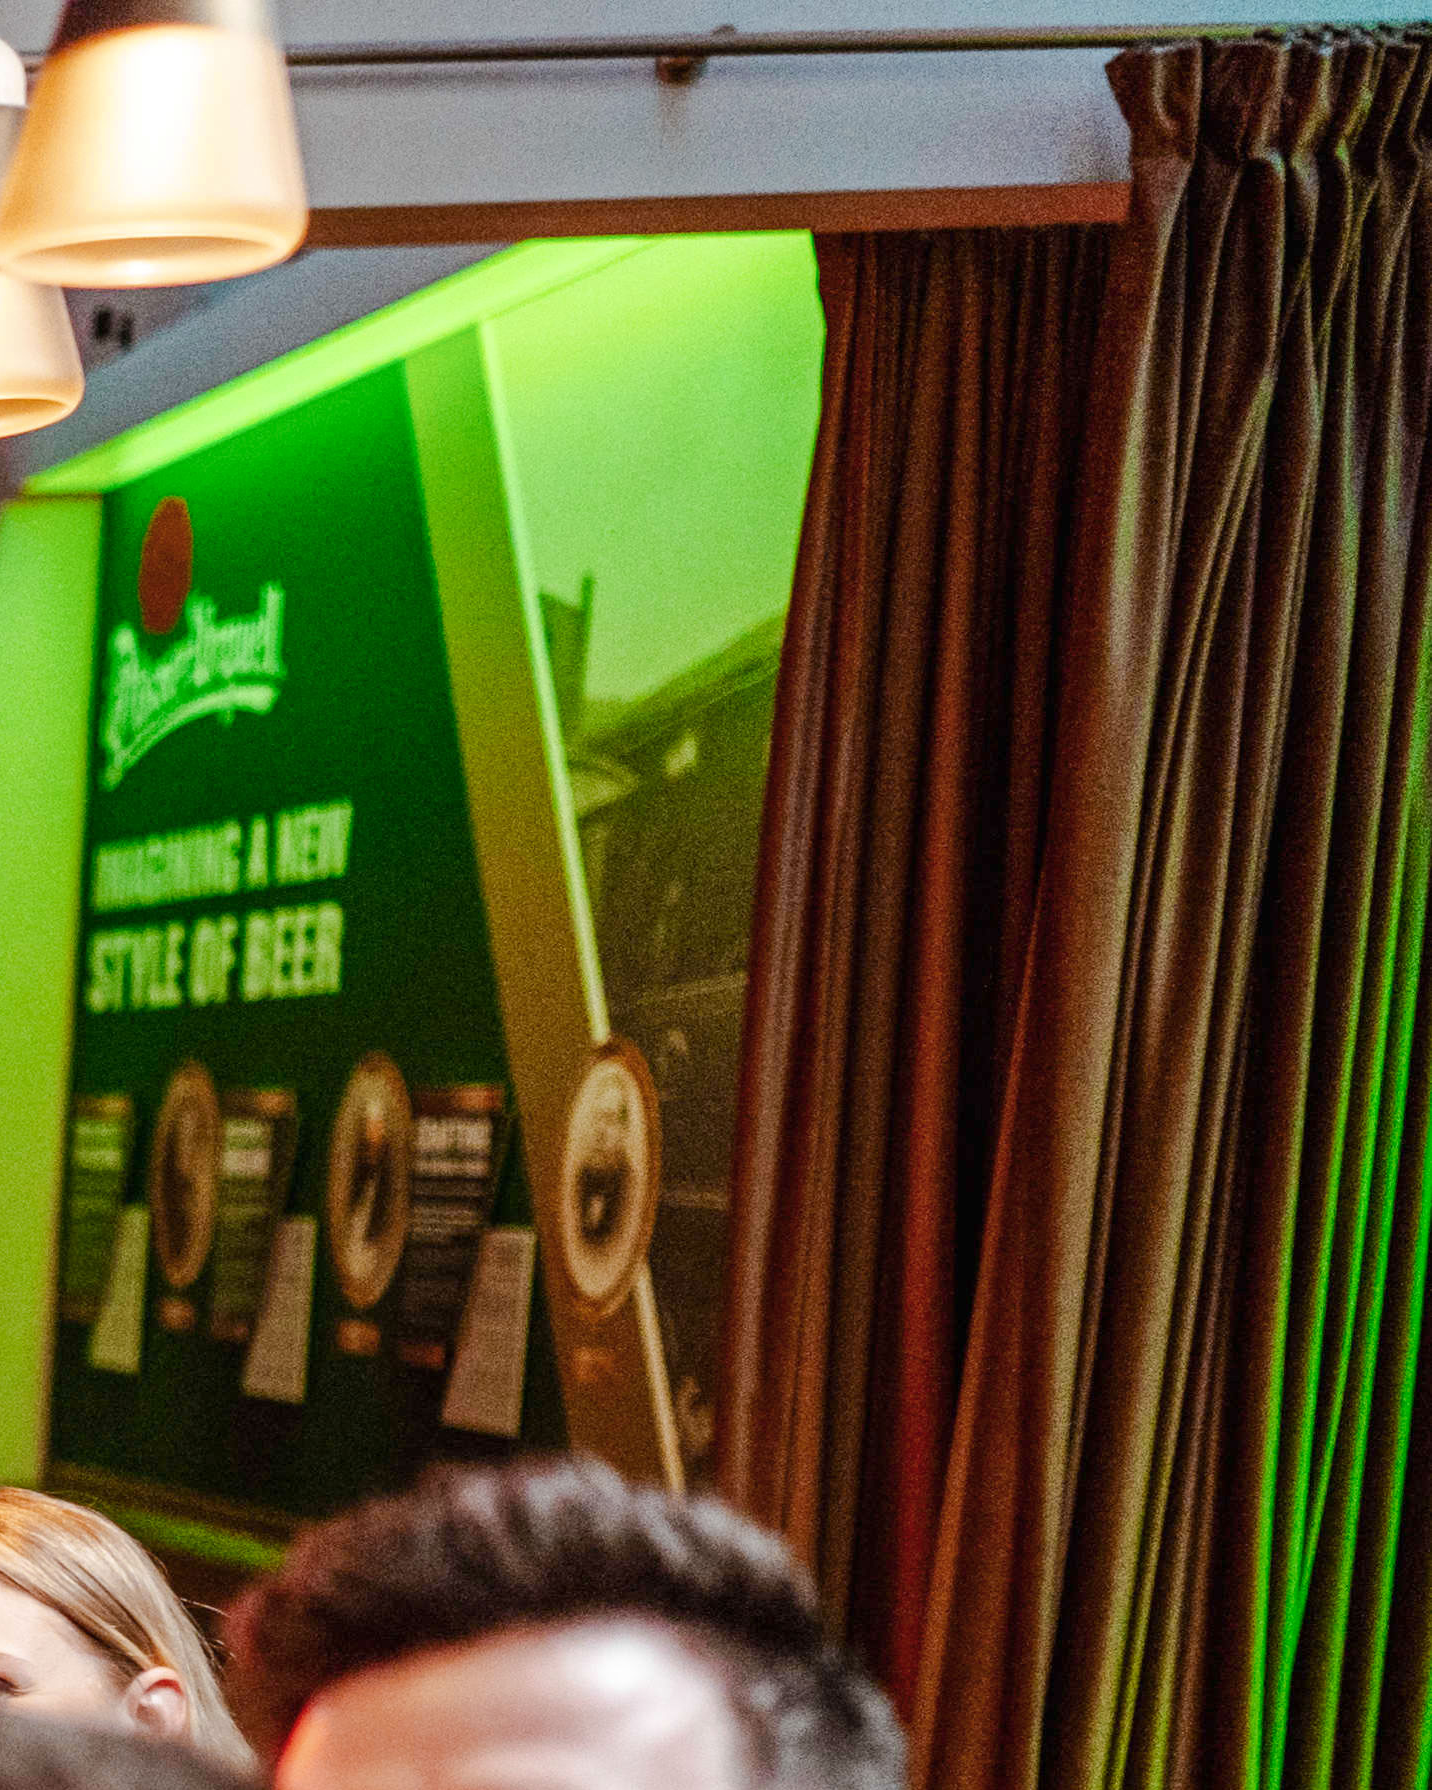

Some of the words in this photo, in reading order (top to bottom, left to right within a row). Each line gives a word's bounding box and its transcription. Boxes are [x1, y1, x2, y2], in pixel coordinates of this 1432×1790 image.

[275, 798, 353, 883] NEW
[89, 922, 184, 1012] STYLE
[189, 914, 238, 1006] OF
[243, 901, 344, 1002] BEER
